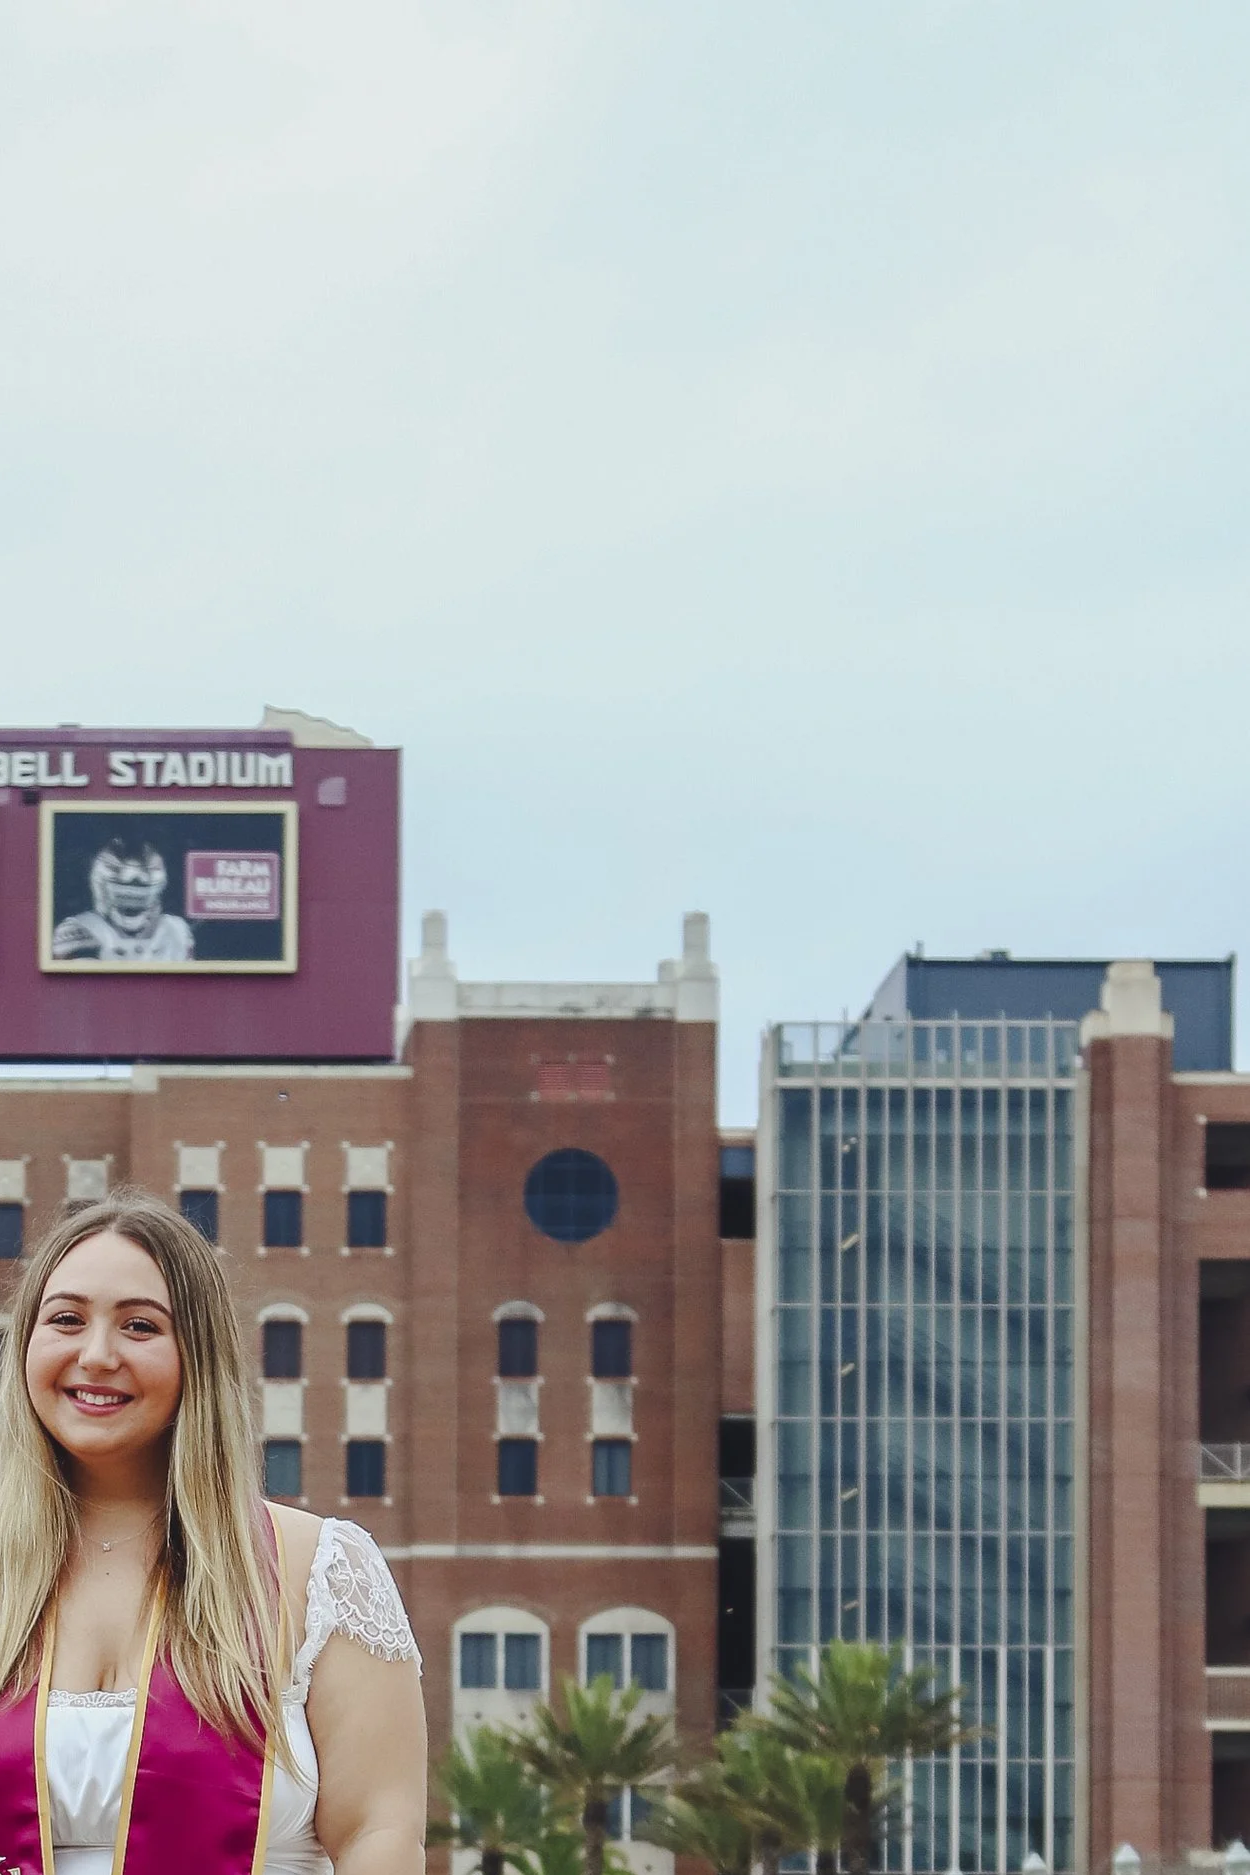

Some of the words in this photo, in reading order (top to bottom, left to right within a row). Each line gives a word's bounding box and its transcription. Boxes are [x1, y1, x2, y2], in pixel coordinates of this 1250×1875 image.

[107, 751, 293, 788] STADIUM
[216, 859, 270, 876] FARM
[195, 876, 271, 894] BUREAU
